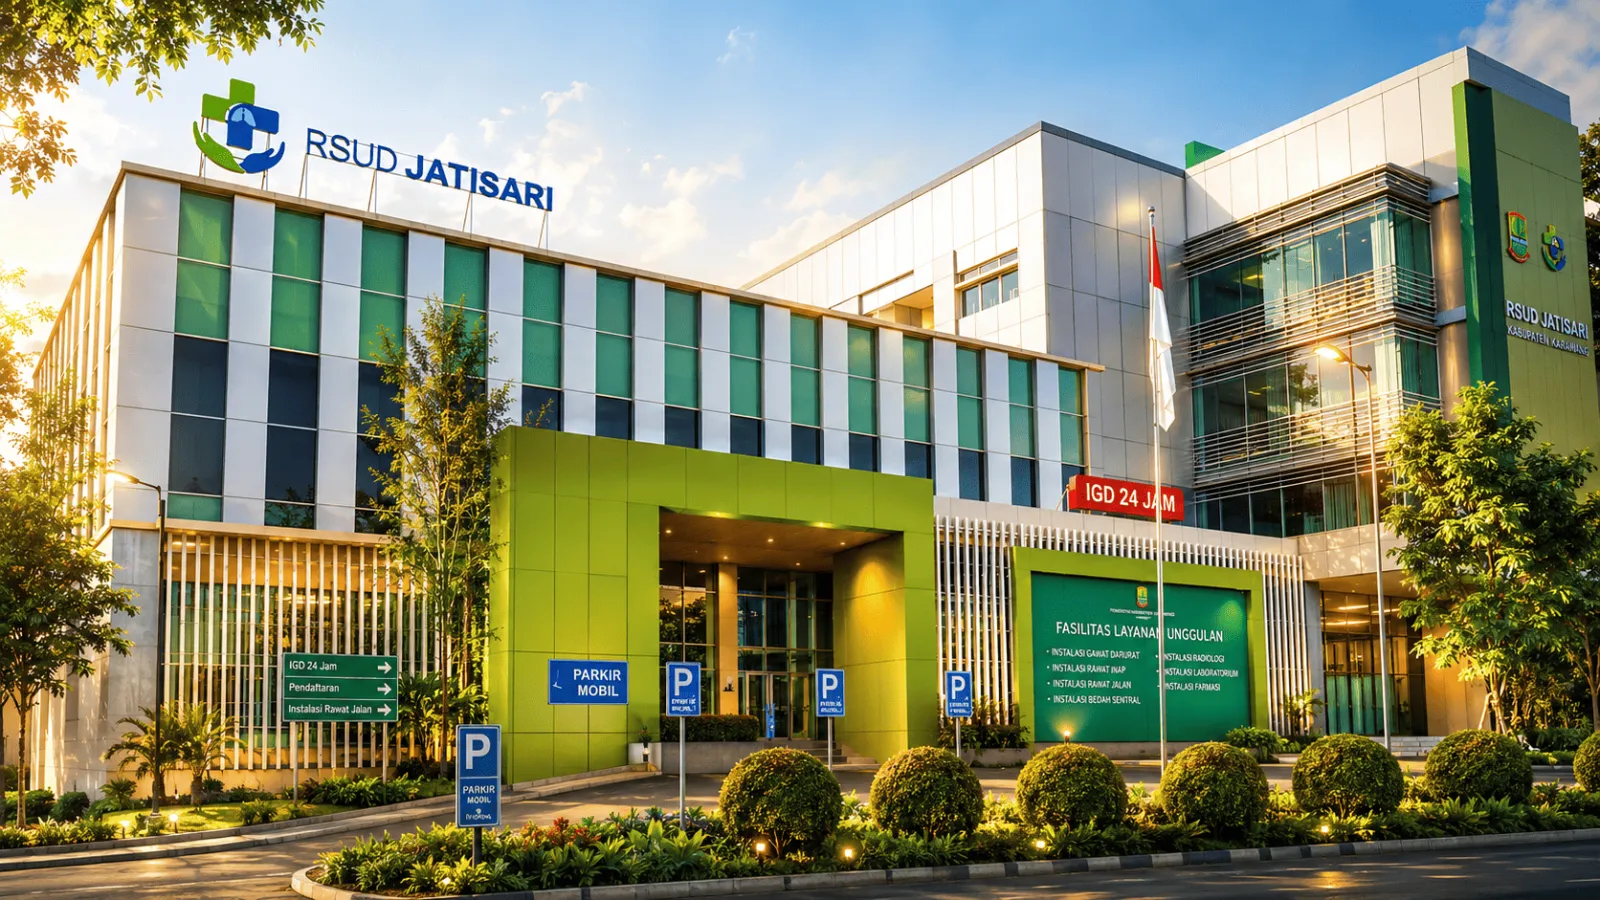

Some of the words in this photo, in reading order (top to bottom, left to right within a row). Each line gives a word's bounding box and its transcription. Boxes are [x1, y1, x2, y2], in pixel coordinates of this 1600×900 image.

[307, 128, 397, 172] RSUD
[405, 154, 553, 211] JATISARI
[1506, 300, 1539, 325] RSUD
[1541, 311, 1589, 340] JATISARI
[1086, 482, 1115, 503] IGD
[1119, 487, 1138, 507] 24
[1142, 491, 1175, 512] JAM
[1056, 621, 1111, 636] FASILITAS
[1167, 627, 1223, 642] UNGGULAN
[1051, 648, 1085, 657] INSTALASI
[1163, 653, 1193, 662] NSTALASI
[1193, 654, 1225, 663] RADIOLOGI
[289, 661, 305, 670] IGD
[307, 661, 318, 670] 24
[320, 662, 337, 671] Jam
[1052, 664, 1086, 673] INSTALASI
[573, 668, 622, 681] PARKIR
[1164, 668, 1193, 676] NSTALASI
[1194, 669, 1239, 677] LABORATORIUM
[288, 682, 340, 692] Pendaftaran
[674, 668, 693, 696] P
[822, 673, 838, 699] P
[1053, 680, 1087, 689] INSTALASI
[1111, 681, 1131, 689] JALAN
[1165, 682, 1194, 691] NSTALASI
[1195, 683, 1221, 691] FARMASI
[577, 685, 619, 697] MOBIL
[951, 675, 966, 700] P
[1053, 695, 1087, 704] INSTALASI
[1088, 696, 1111, 704] BEDAH
[1112, 696, 1141, 705] SENTRAL
[288, 704, 323, 714] Instalasi
[324, 704, 349, 714] Rawat
[351, 705, 372, 714] Jalan
[465, 733, 491, 770] P
[462, 785, 495, 795] PARKIR
